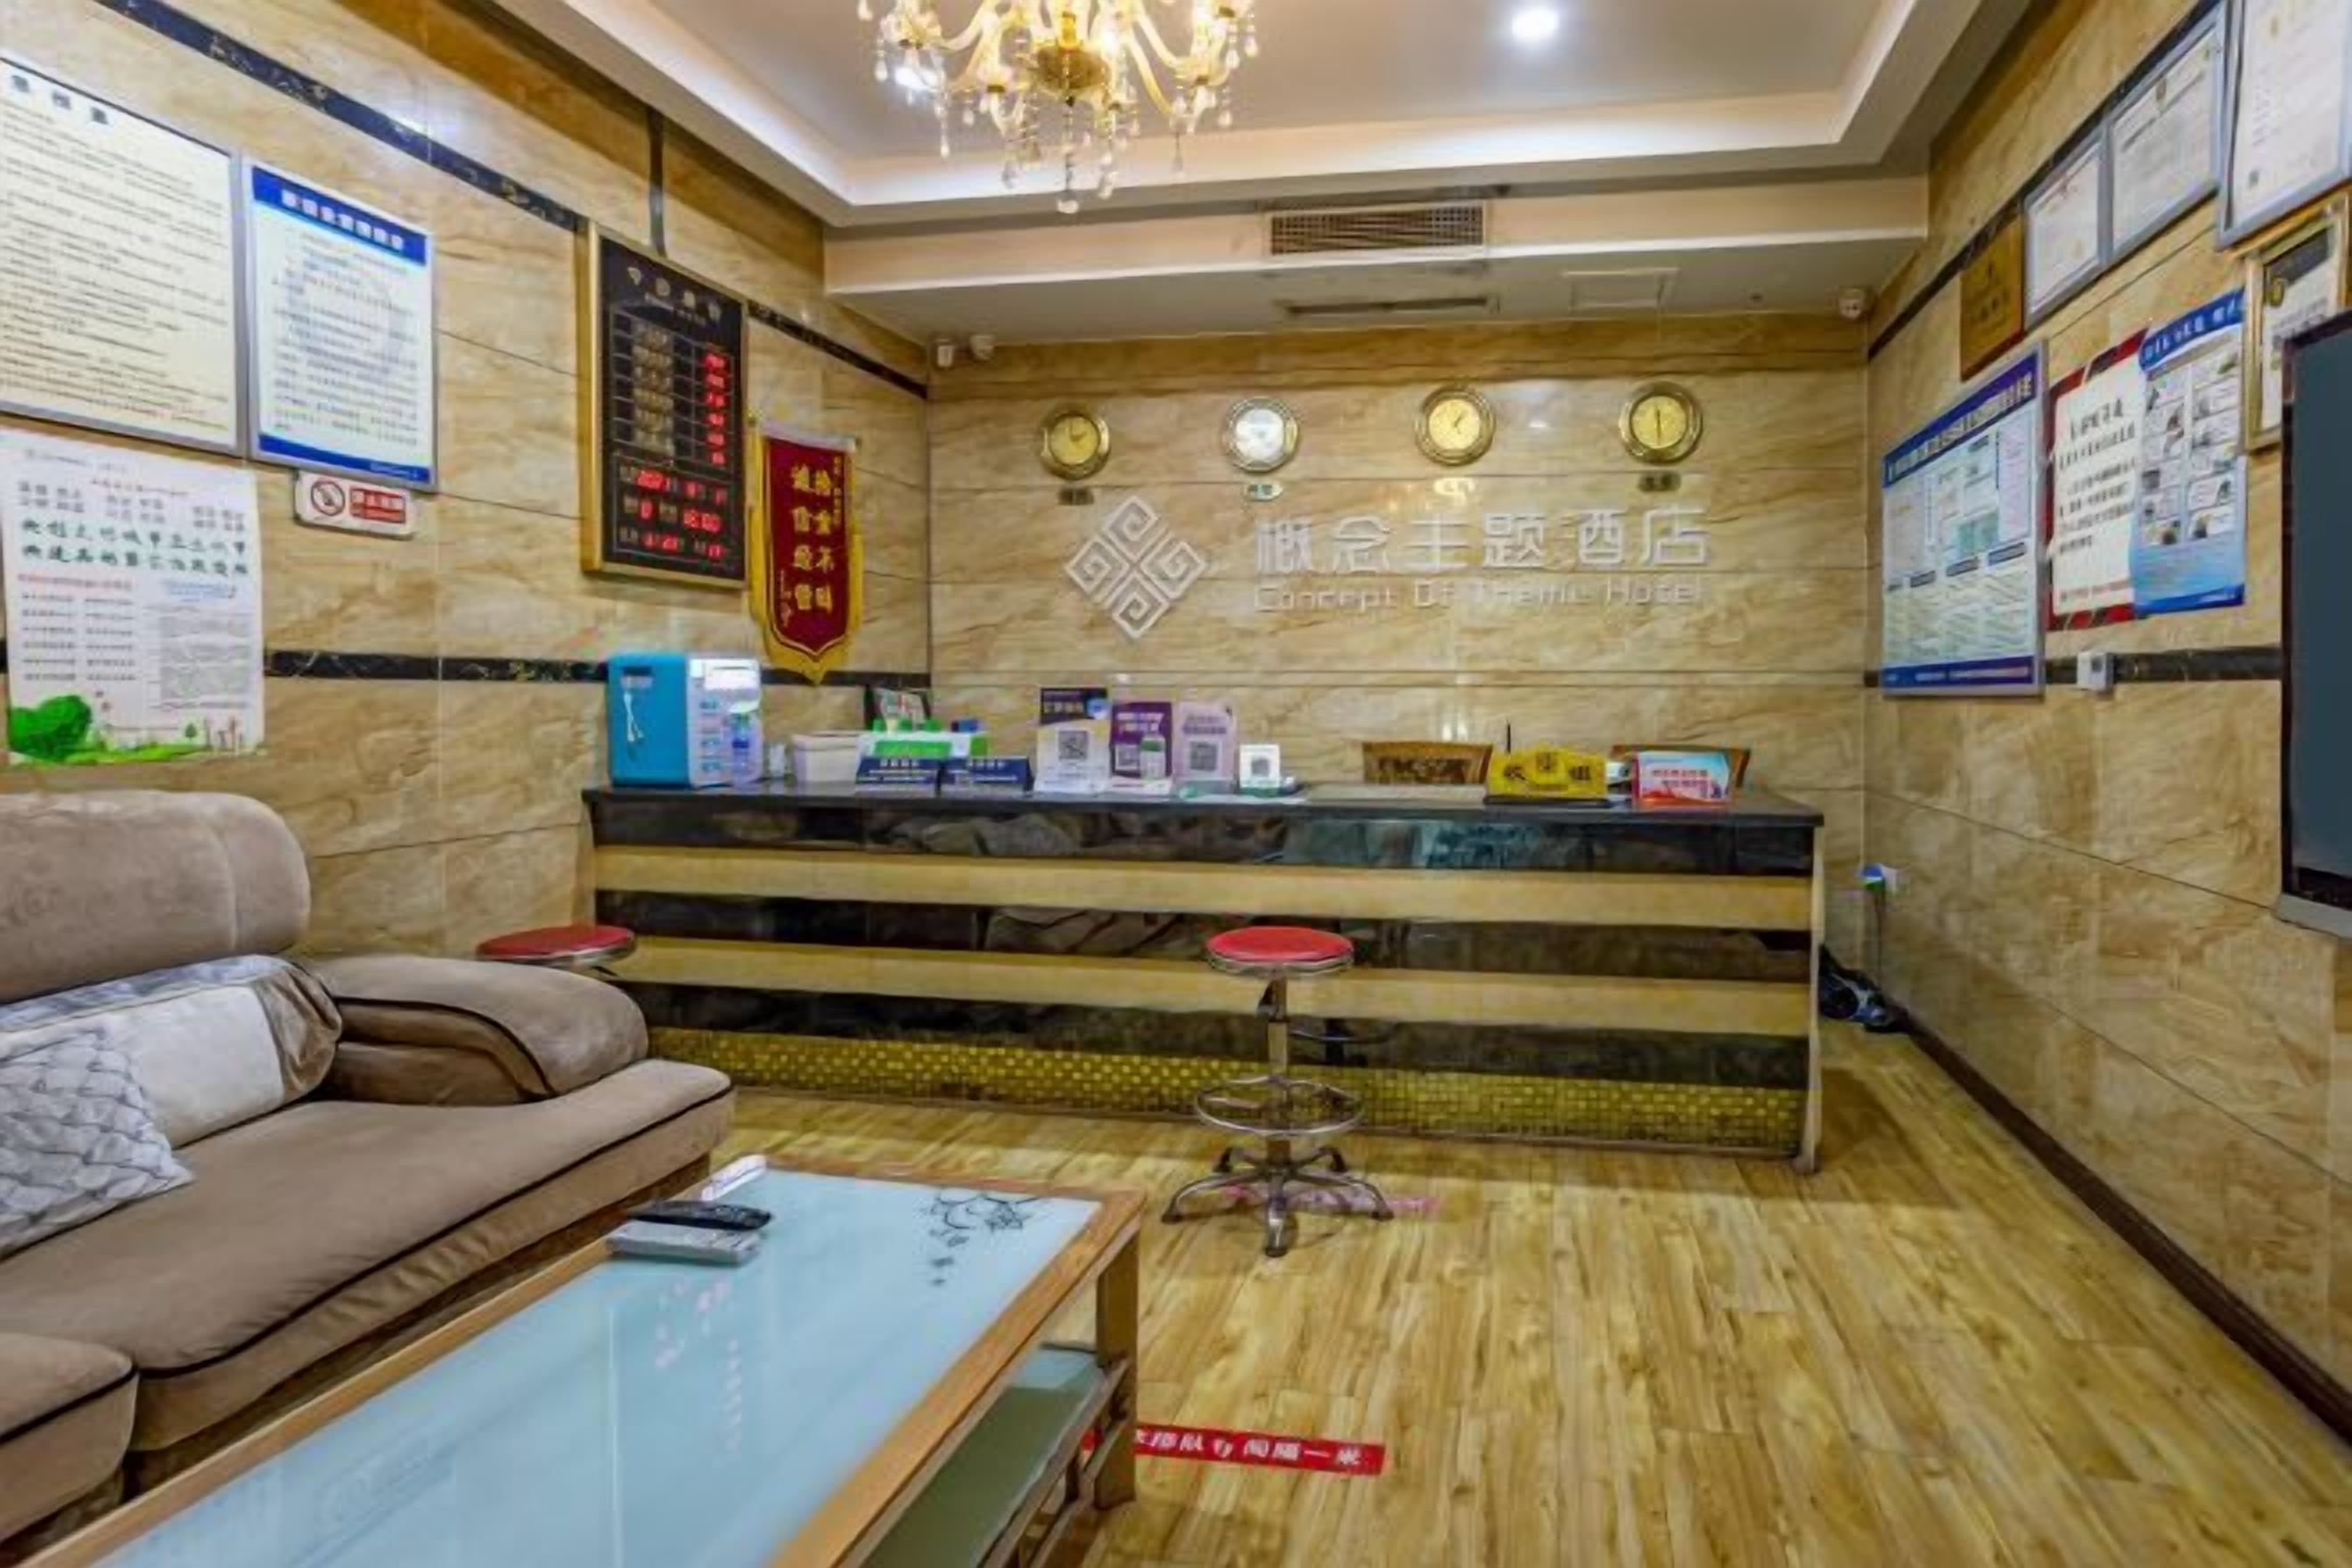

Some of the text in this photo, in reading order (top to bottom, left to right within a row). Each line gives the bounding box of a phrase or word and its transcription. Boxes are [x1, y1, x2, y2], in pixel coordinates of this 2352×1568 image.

[1254, 506, 1709, 572] 概念主题酒店
[1255, 583, 1396, 614] Concept
[1607, 574, 1701, 606] Hotel
